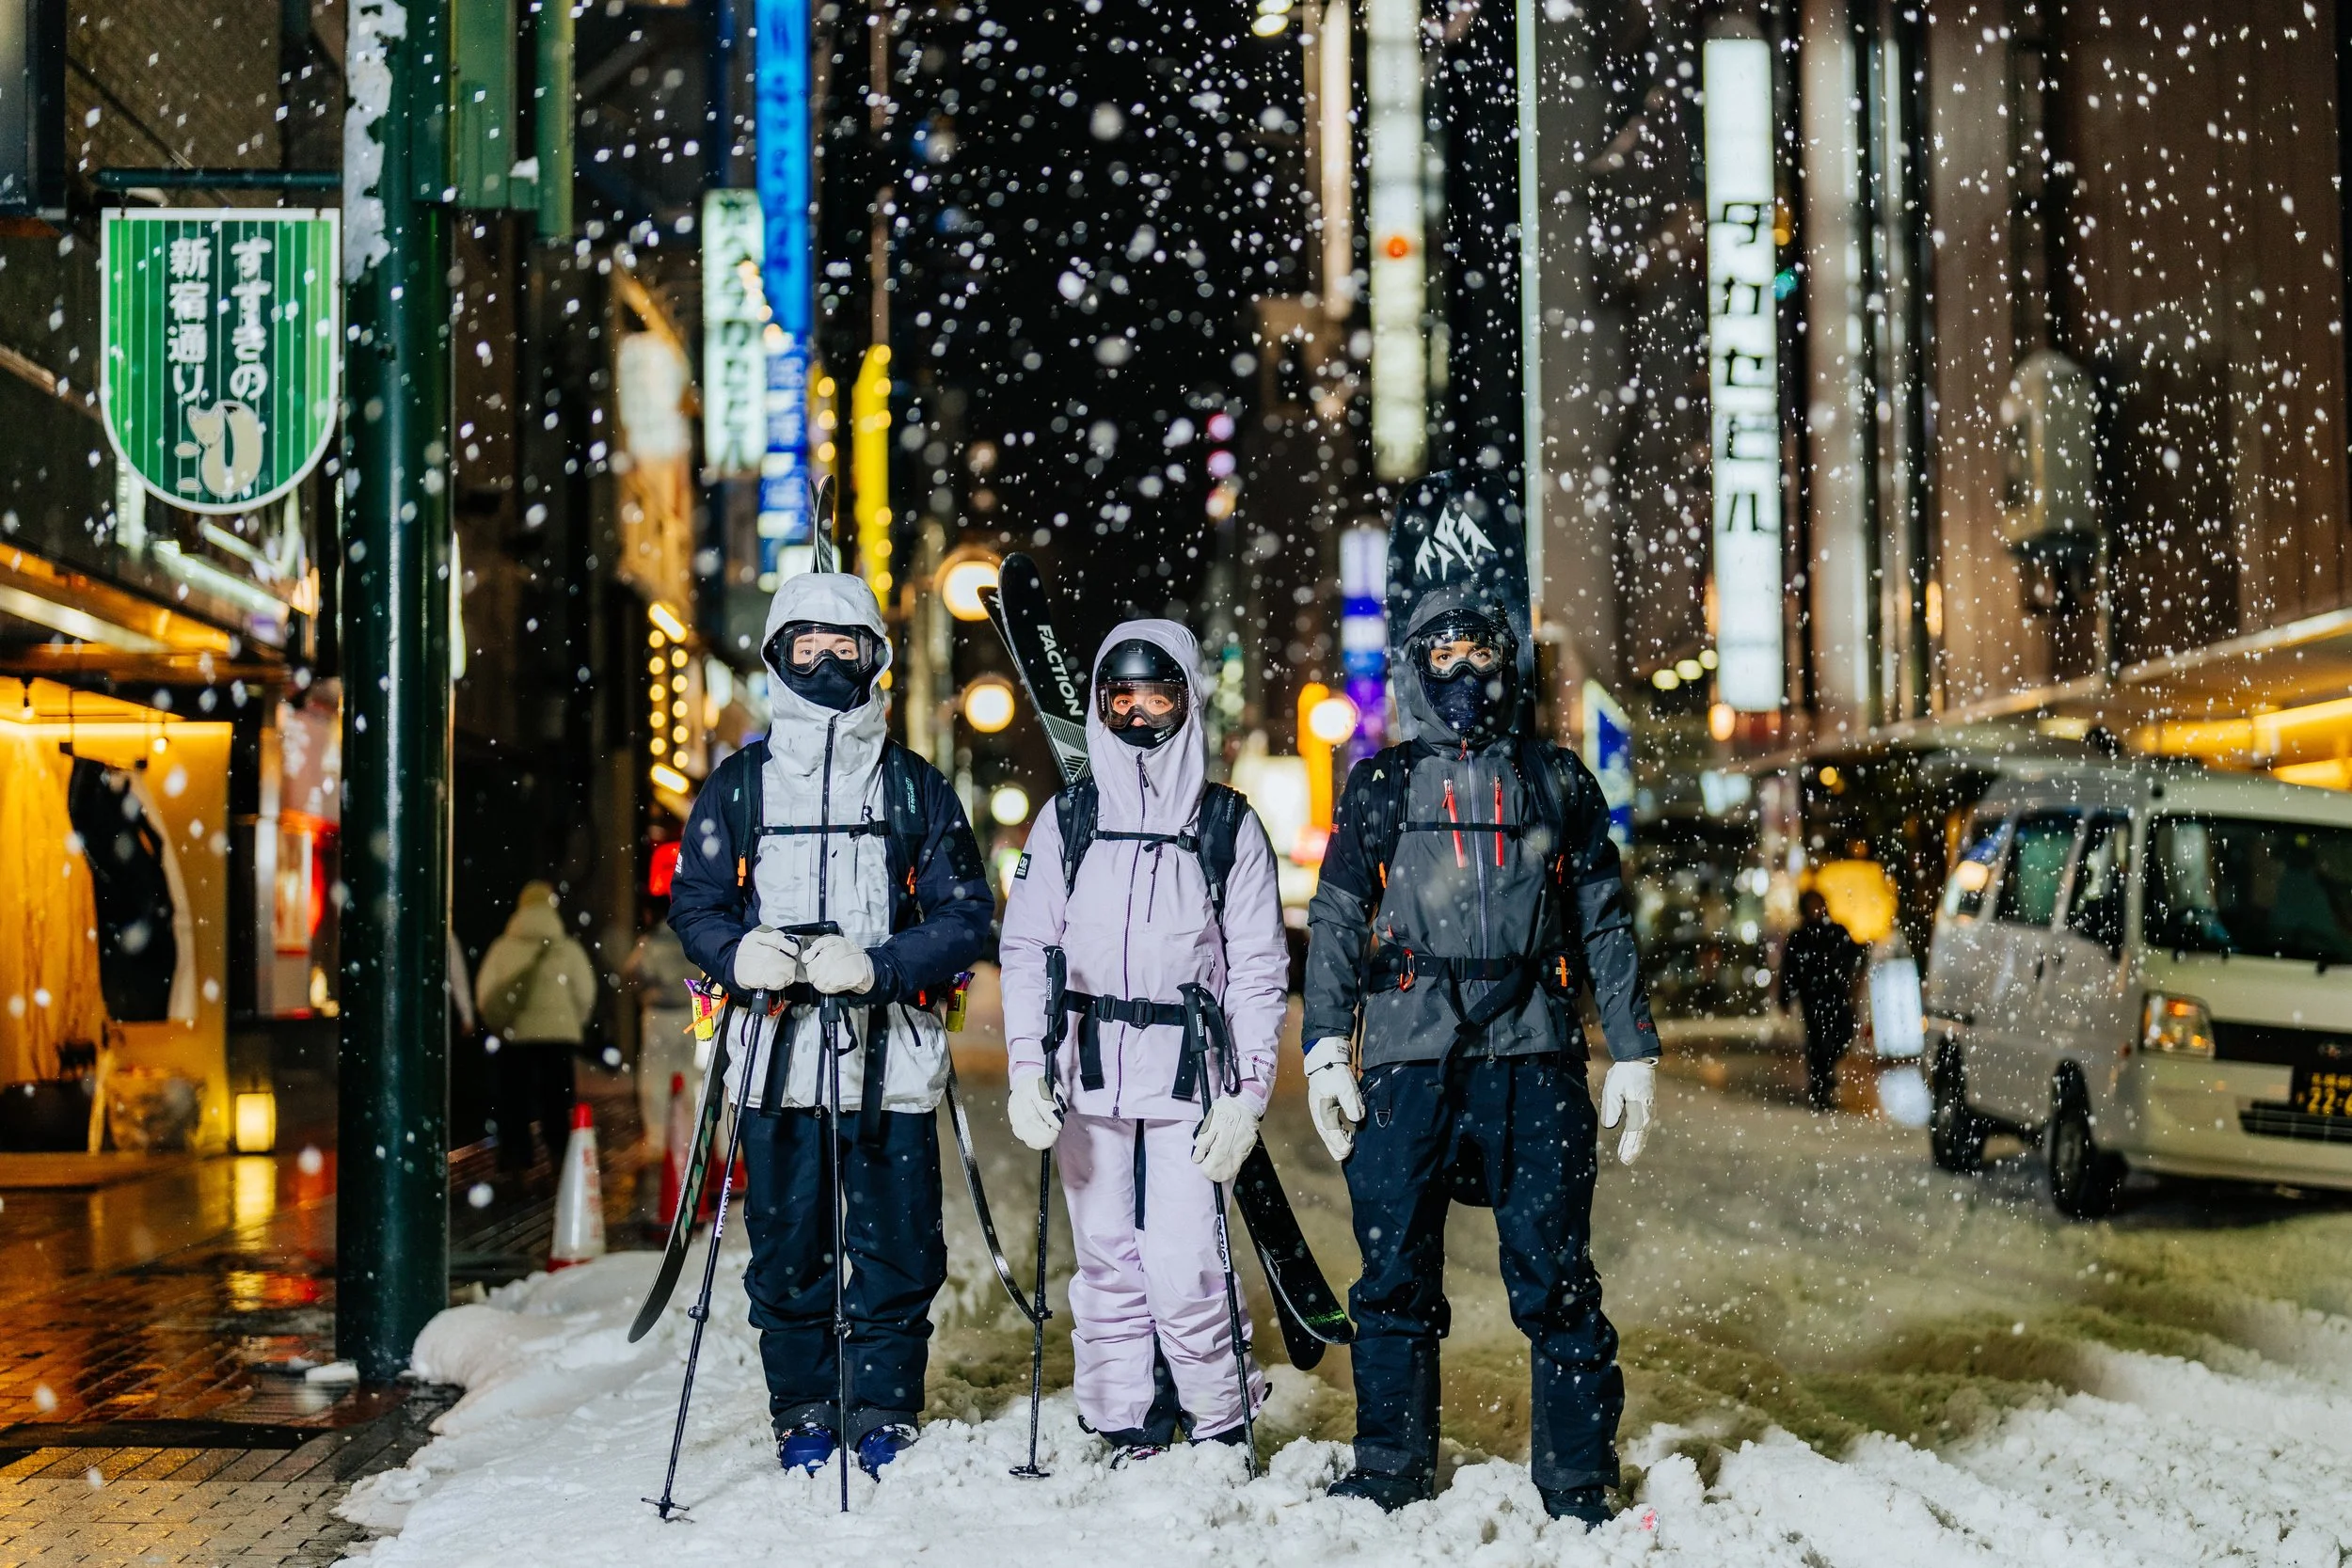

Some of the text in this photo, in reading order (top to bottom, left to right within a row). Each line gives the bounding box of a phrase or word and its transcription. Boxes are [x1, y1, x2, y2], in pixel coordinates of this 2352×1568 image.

[167, 237, 212, 402] 新宿通り
[230, 236, 273, 401] すすきの
[1037, 624, 1084, 717] FACTION
